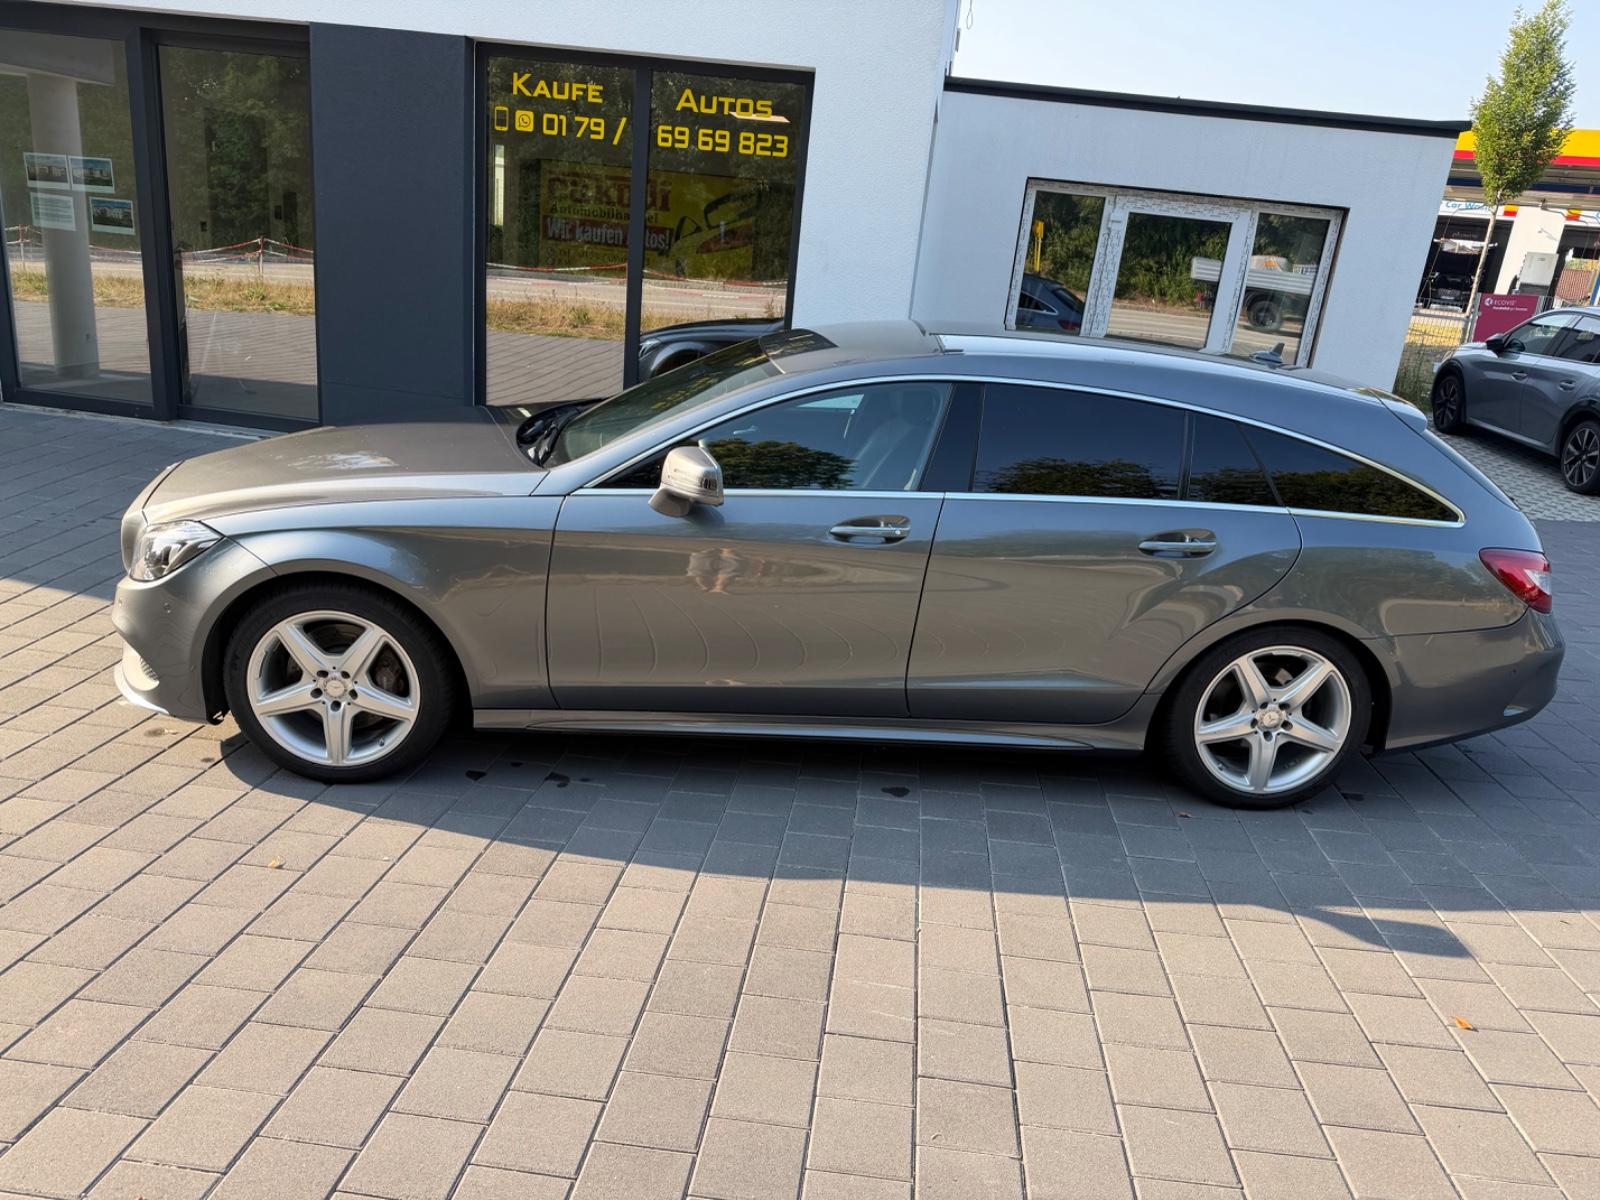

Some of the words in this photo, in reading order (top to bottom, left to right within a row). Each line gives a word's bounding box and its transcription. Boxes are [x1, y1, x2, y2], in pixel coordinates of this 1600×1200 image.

[512, 72, 604, 104] KAUFE
[675, 88, 773, 118] AUTOS
[657, 125, 690, 149] 69
[697, 129, 730, 152] 69
[738, 131, 789, 158] 823
[547, 217, 572, 241] Wir
[575, 221, 624, 246] kaufen
[627, 228, 670, 250] tos!
